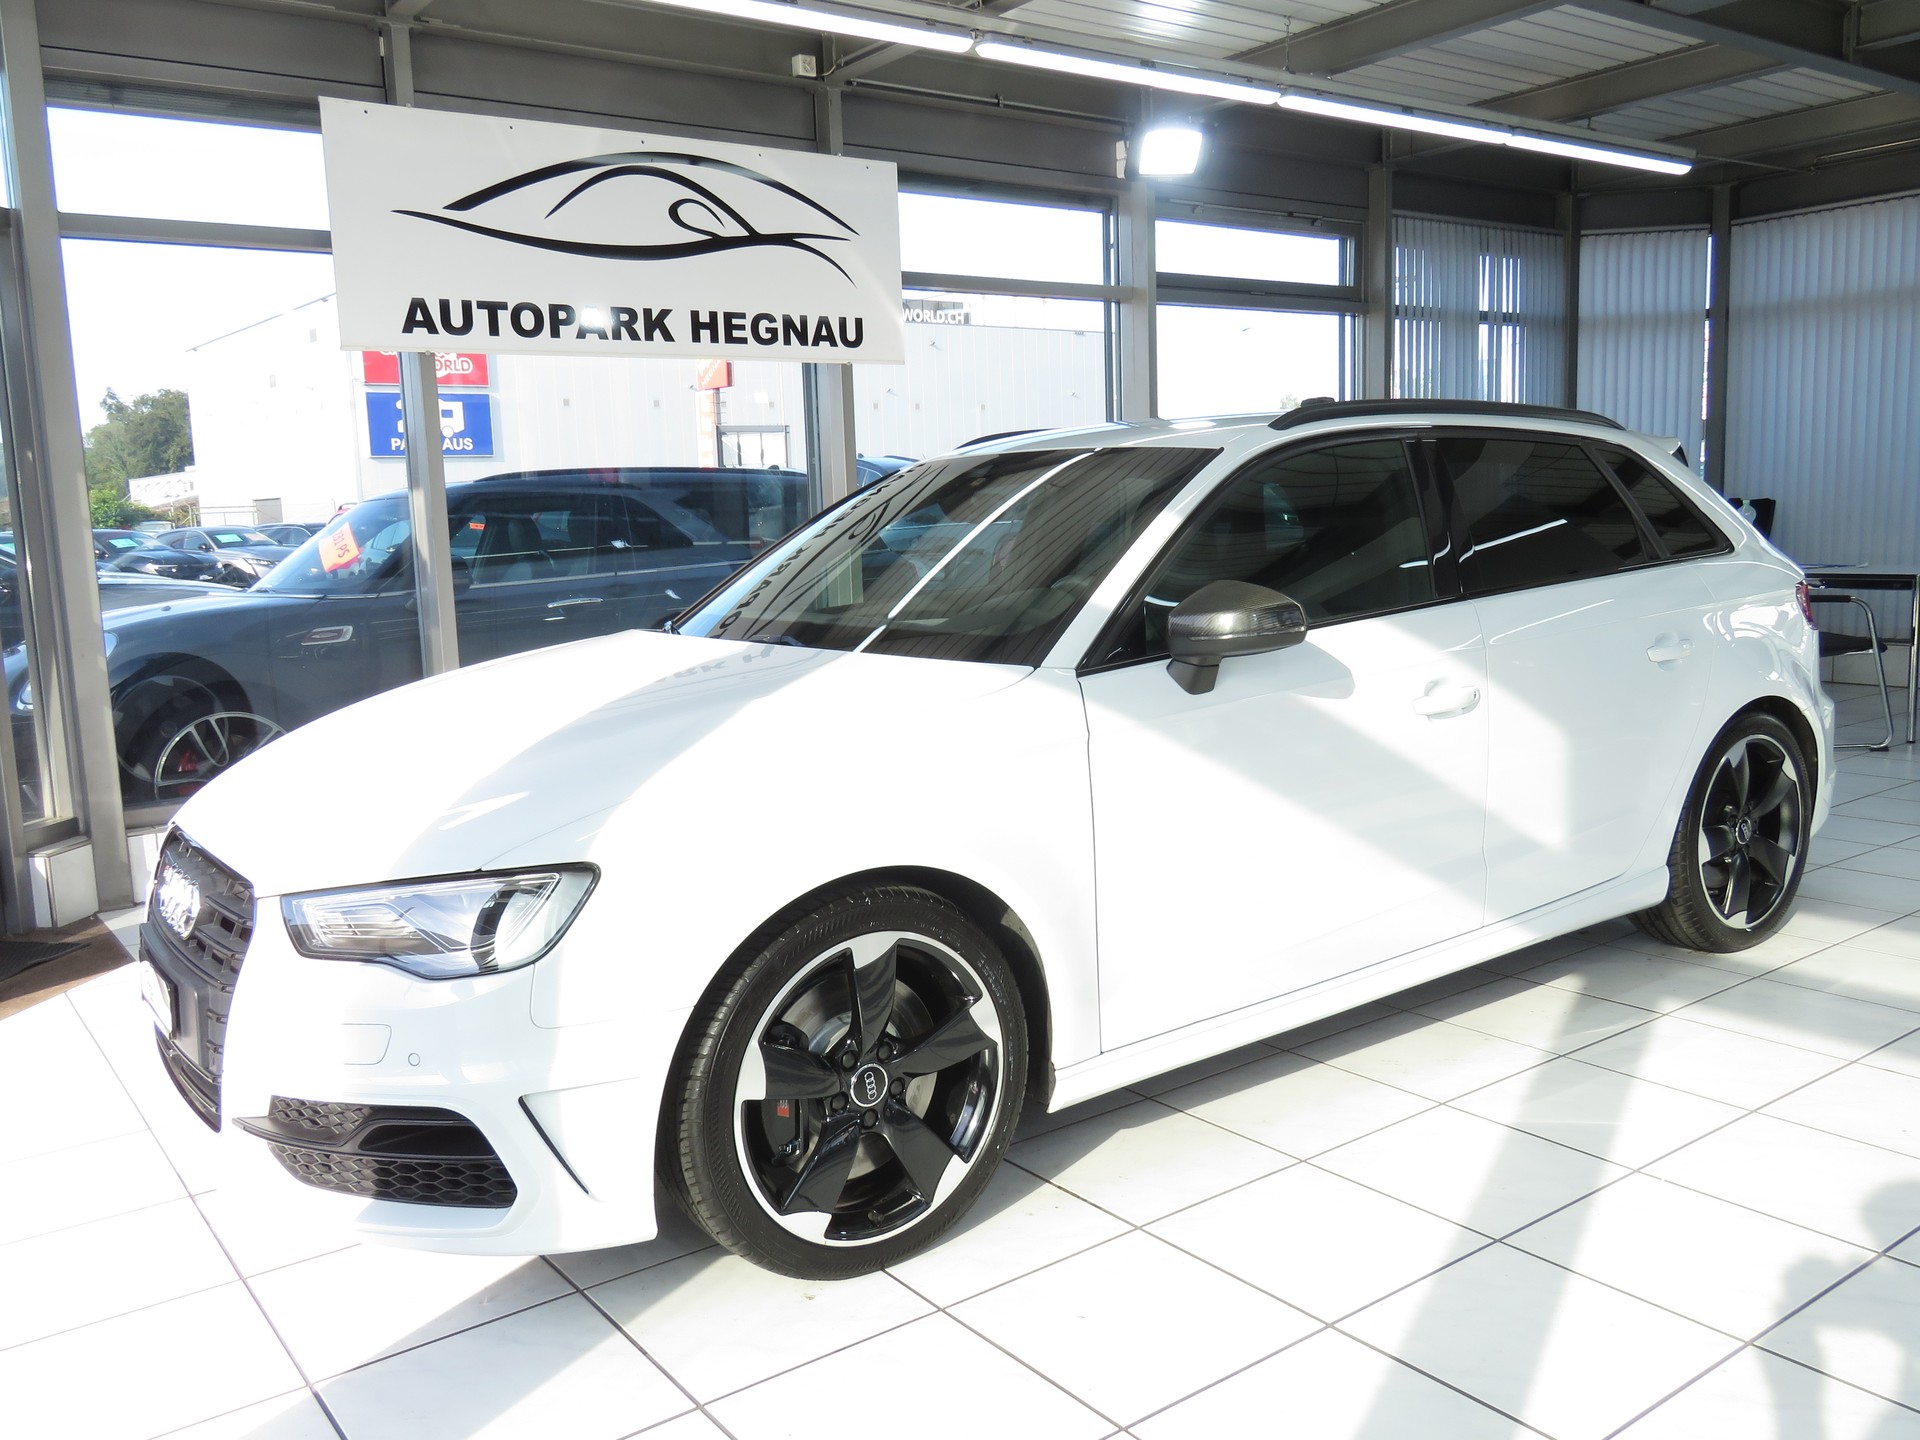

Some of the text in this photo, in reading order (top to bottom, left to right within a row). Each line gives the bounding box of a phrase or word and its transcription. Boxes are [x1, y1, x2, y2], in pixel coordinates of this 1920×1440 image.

[402, 297, 864, 348] AUTOPARK HEGNAU
[902, 308, 964, 325] WORLD.CH
